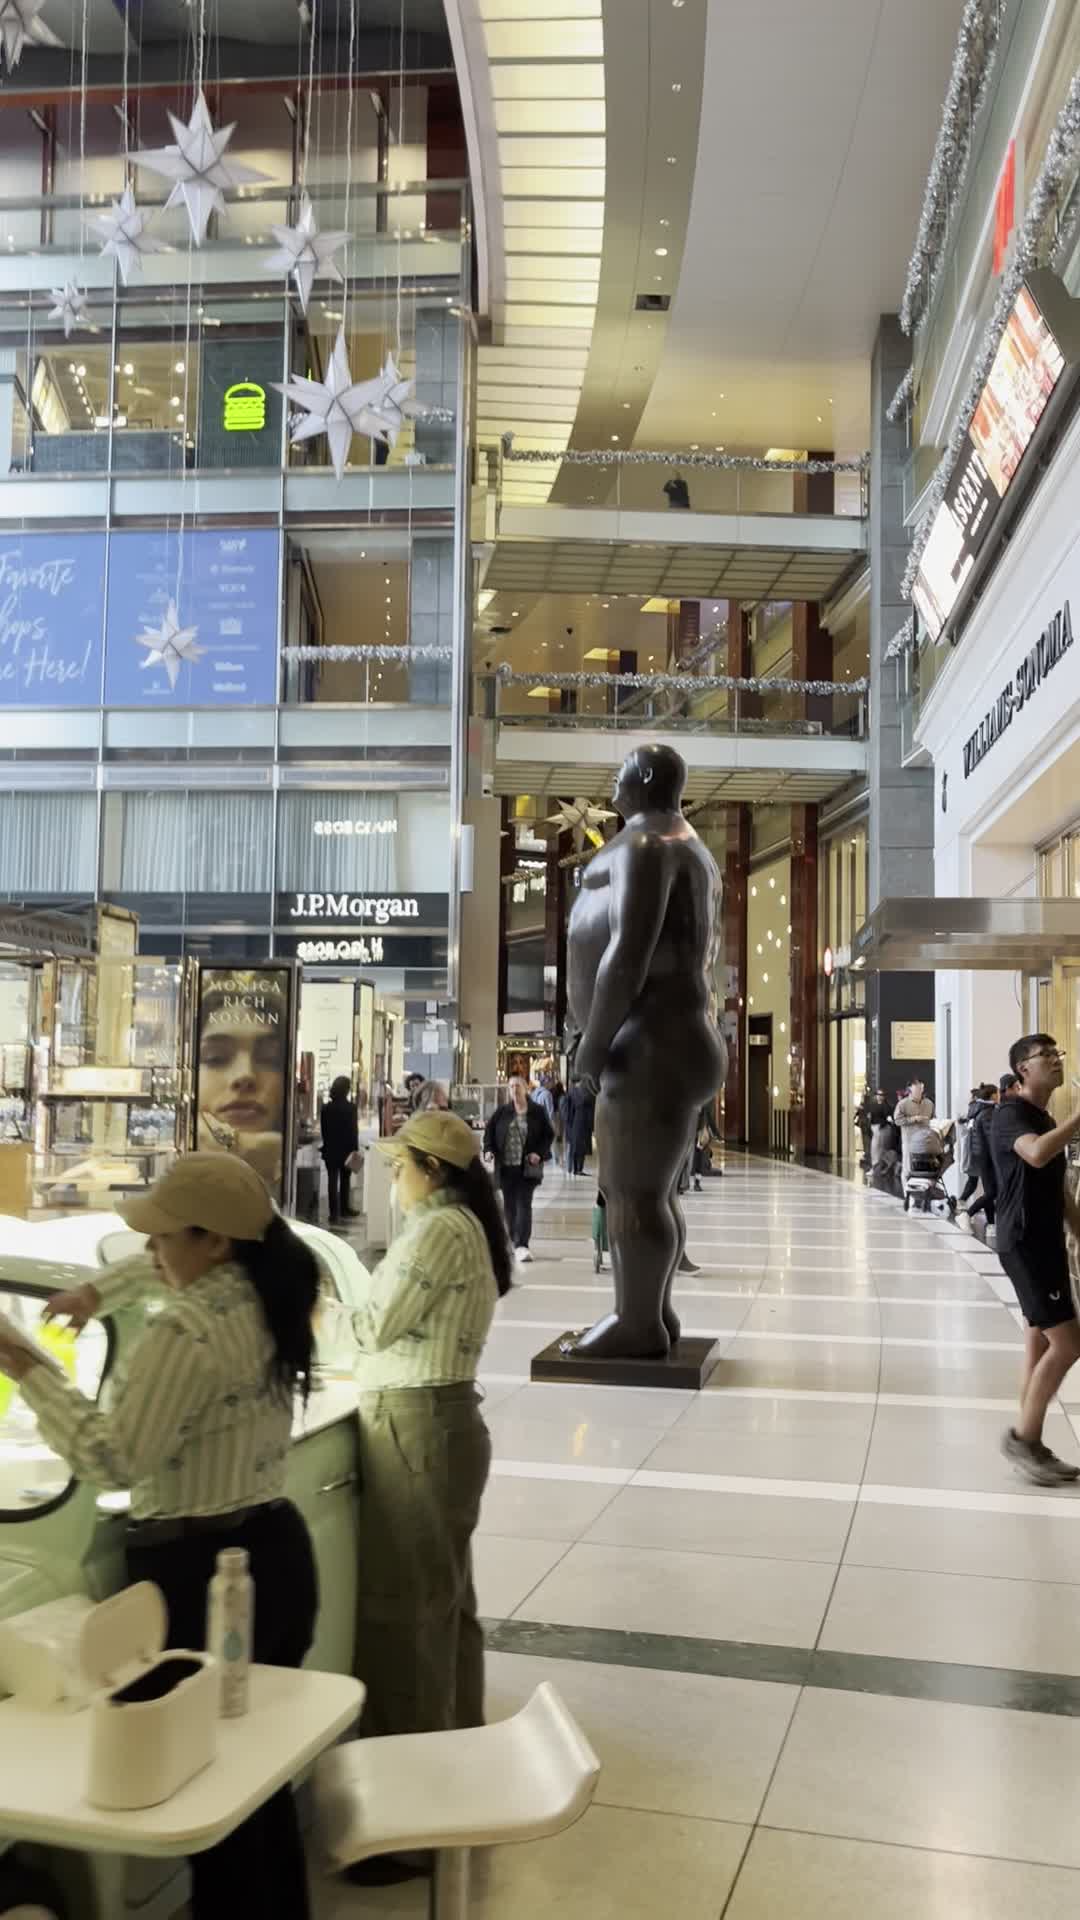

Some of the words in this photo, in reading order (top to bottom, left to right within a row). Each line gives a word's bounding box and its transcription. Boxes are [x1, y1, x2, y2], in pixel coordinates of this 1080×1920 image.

[25, 640, 91, 687] Here!
[290, 894, 419, 924] J.P.Morgan
[208, 980, 280, 993] MONICA
[223, 995, 265, 1008] RICH
[209, 1011, 279, 1024] KOSANN
[318, 1034, 338, 1092] Thera
